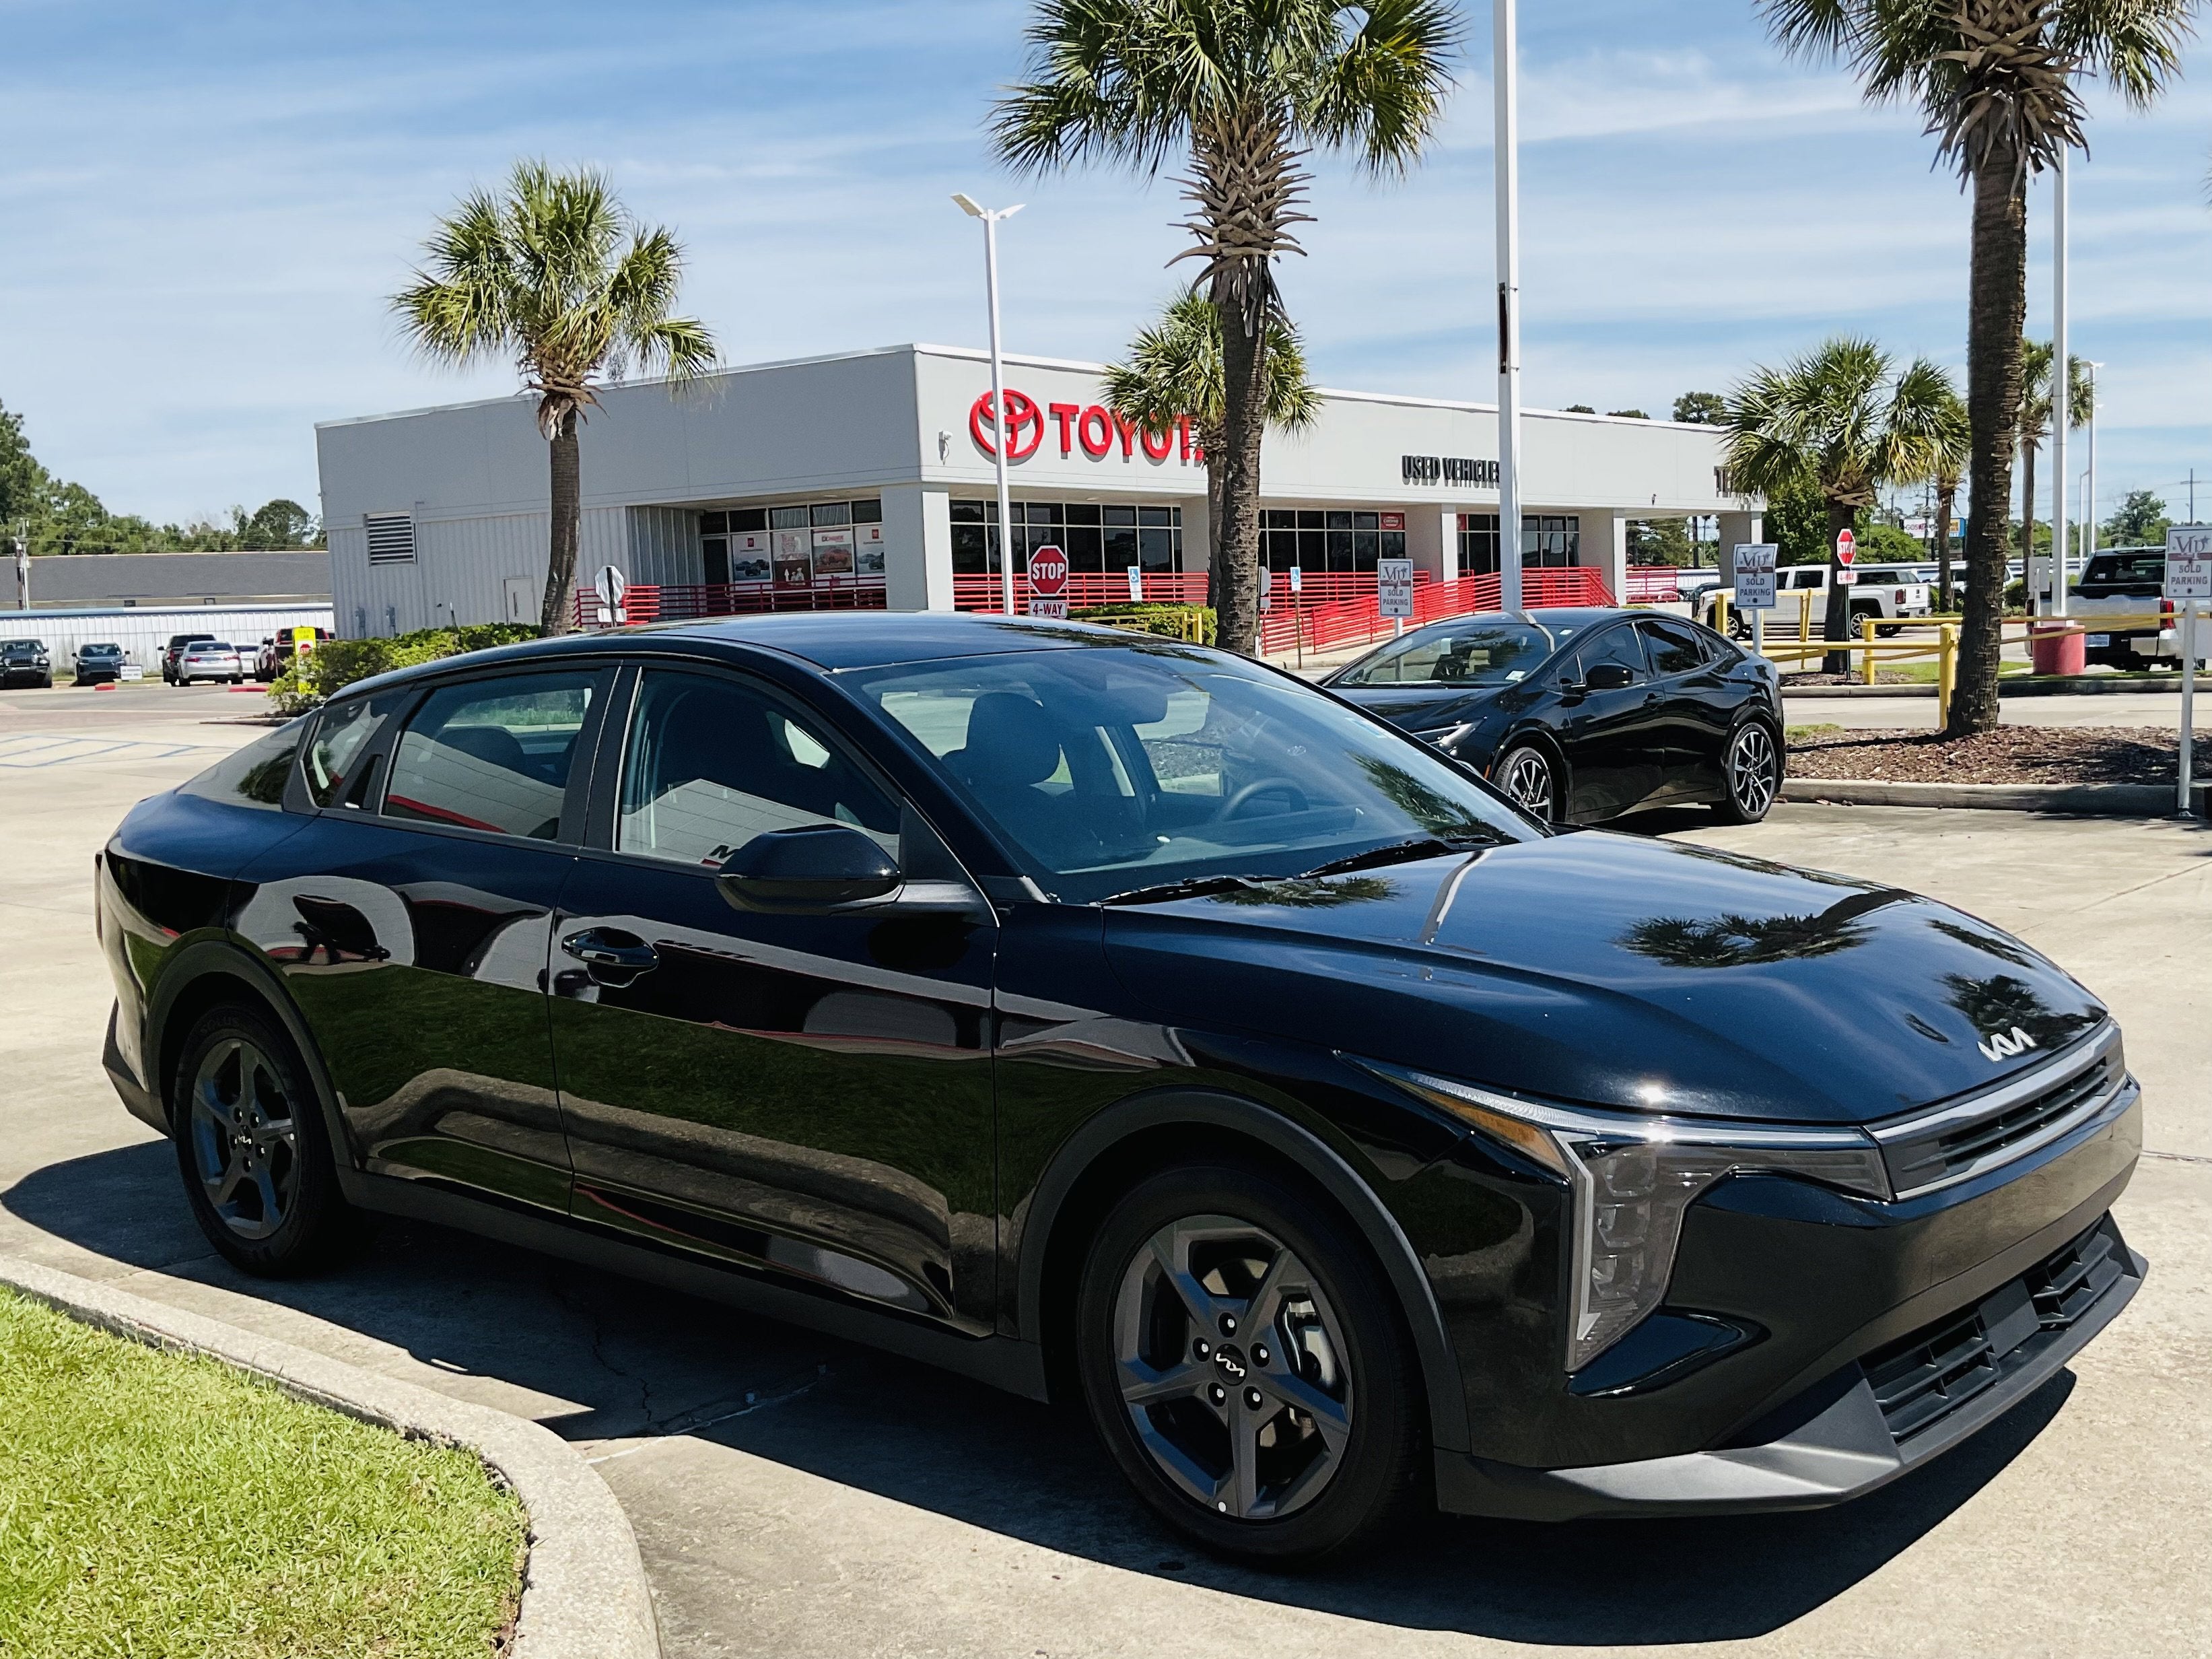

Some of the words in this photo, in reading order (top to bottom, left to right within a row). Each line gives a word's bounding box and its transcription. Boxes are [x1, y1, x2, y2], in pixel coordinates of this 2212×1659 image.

[1049, 402, 1205, 461] TOYOT
[1402, 455, 1441, 480] USED
[1442, 457, 1500, 483] VEHICLE
[1838, 541, 1854, 554] STOP
[1032, 562, 1066, 580] STOP
[2178, 565, 2201, 573] SOLD
[1746, 578, 1765, 586] SOLD
[2171, 576, 2208, 585] PARKING
[1739, 588, 1770, 597] PARKING
[1033, 603, 1063, 615] 4-WAY
